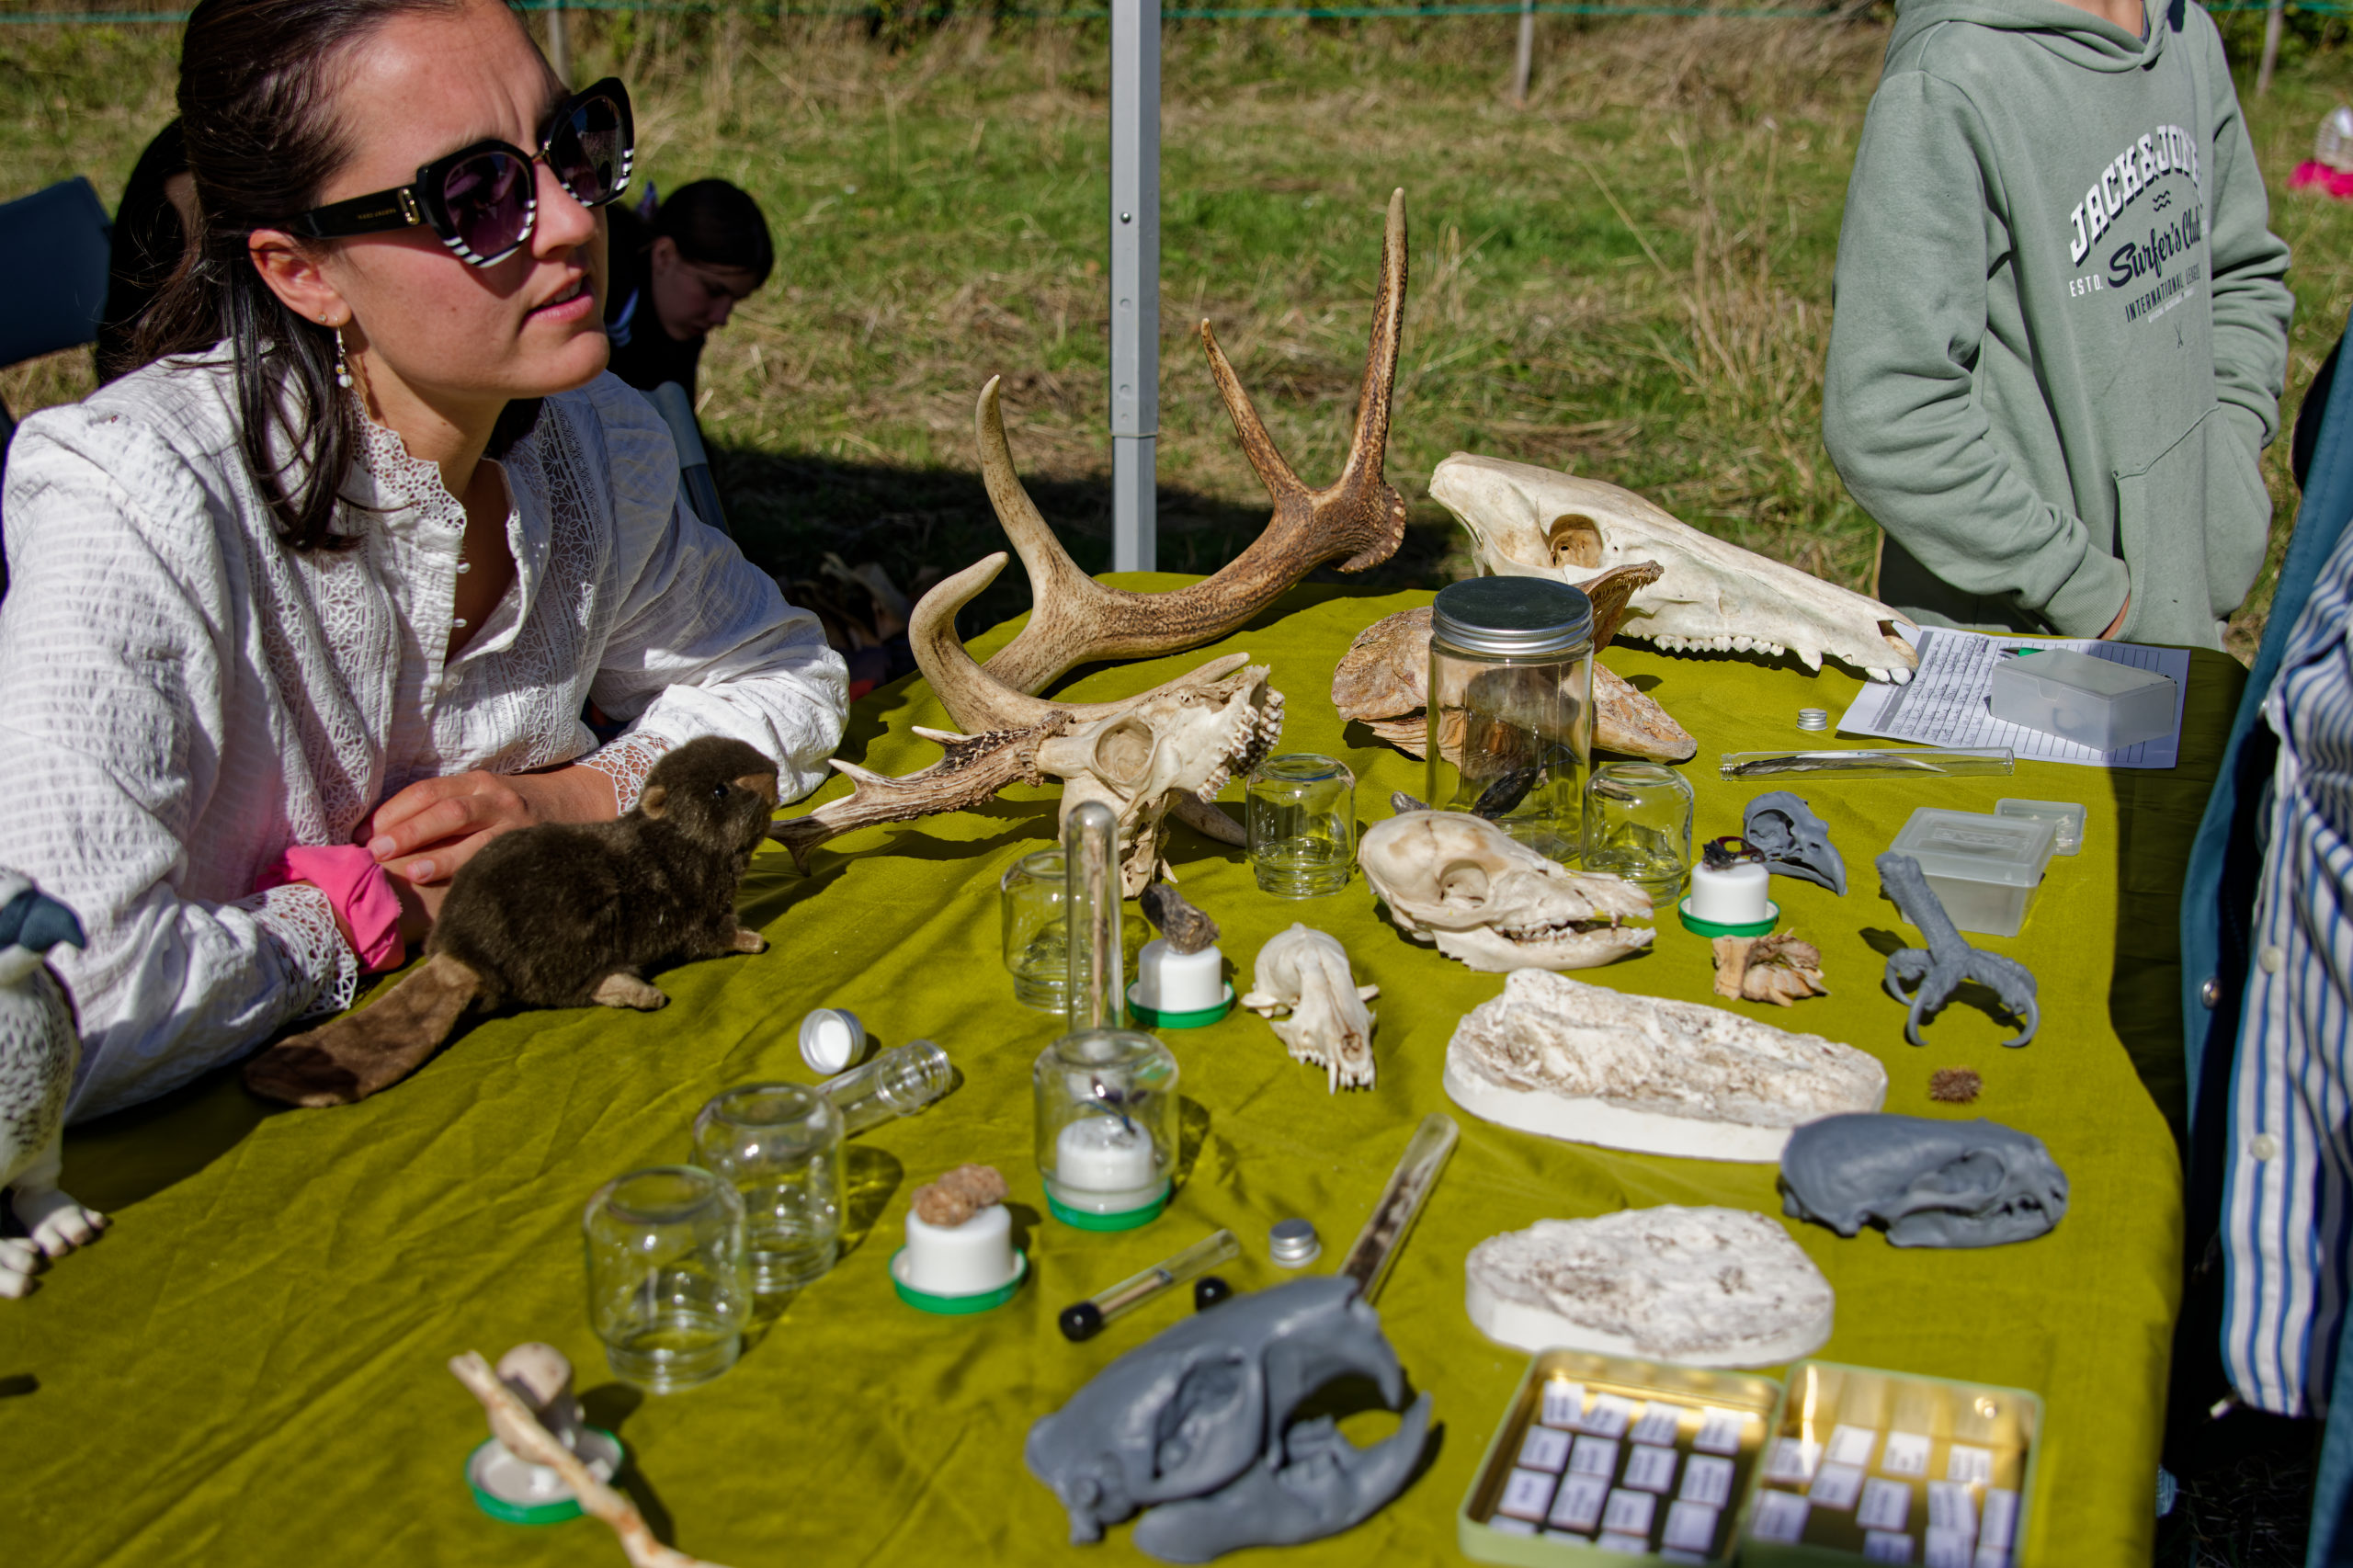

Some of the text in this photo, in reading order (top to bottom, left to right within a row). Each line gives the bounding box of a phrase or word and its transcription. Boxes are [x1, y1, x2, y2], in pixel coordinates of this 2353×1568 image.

[2108, 222, 2182, 289] Surfer's
[2069, 274, 2104, 298] ESTD.
[2125, 272, 2184, 324] INTERNATIONAL
